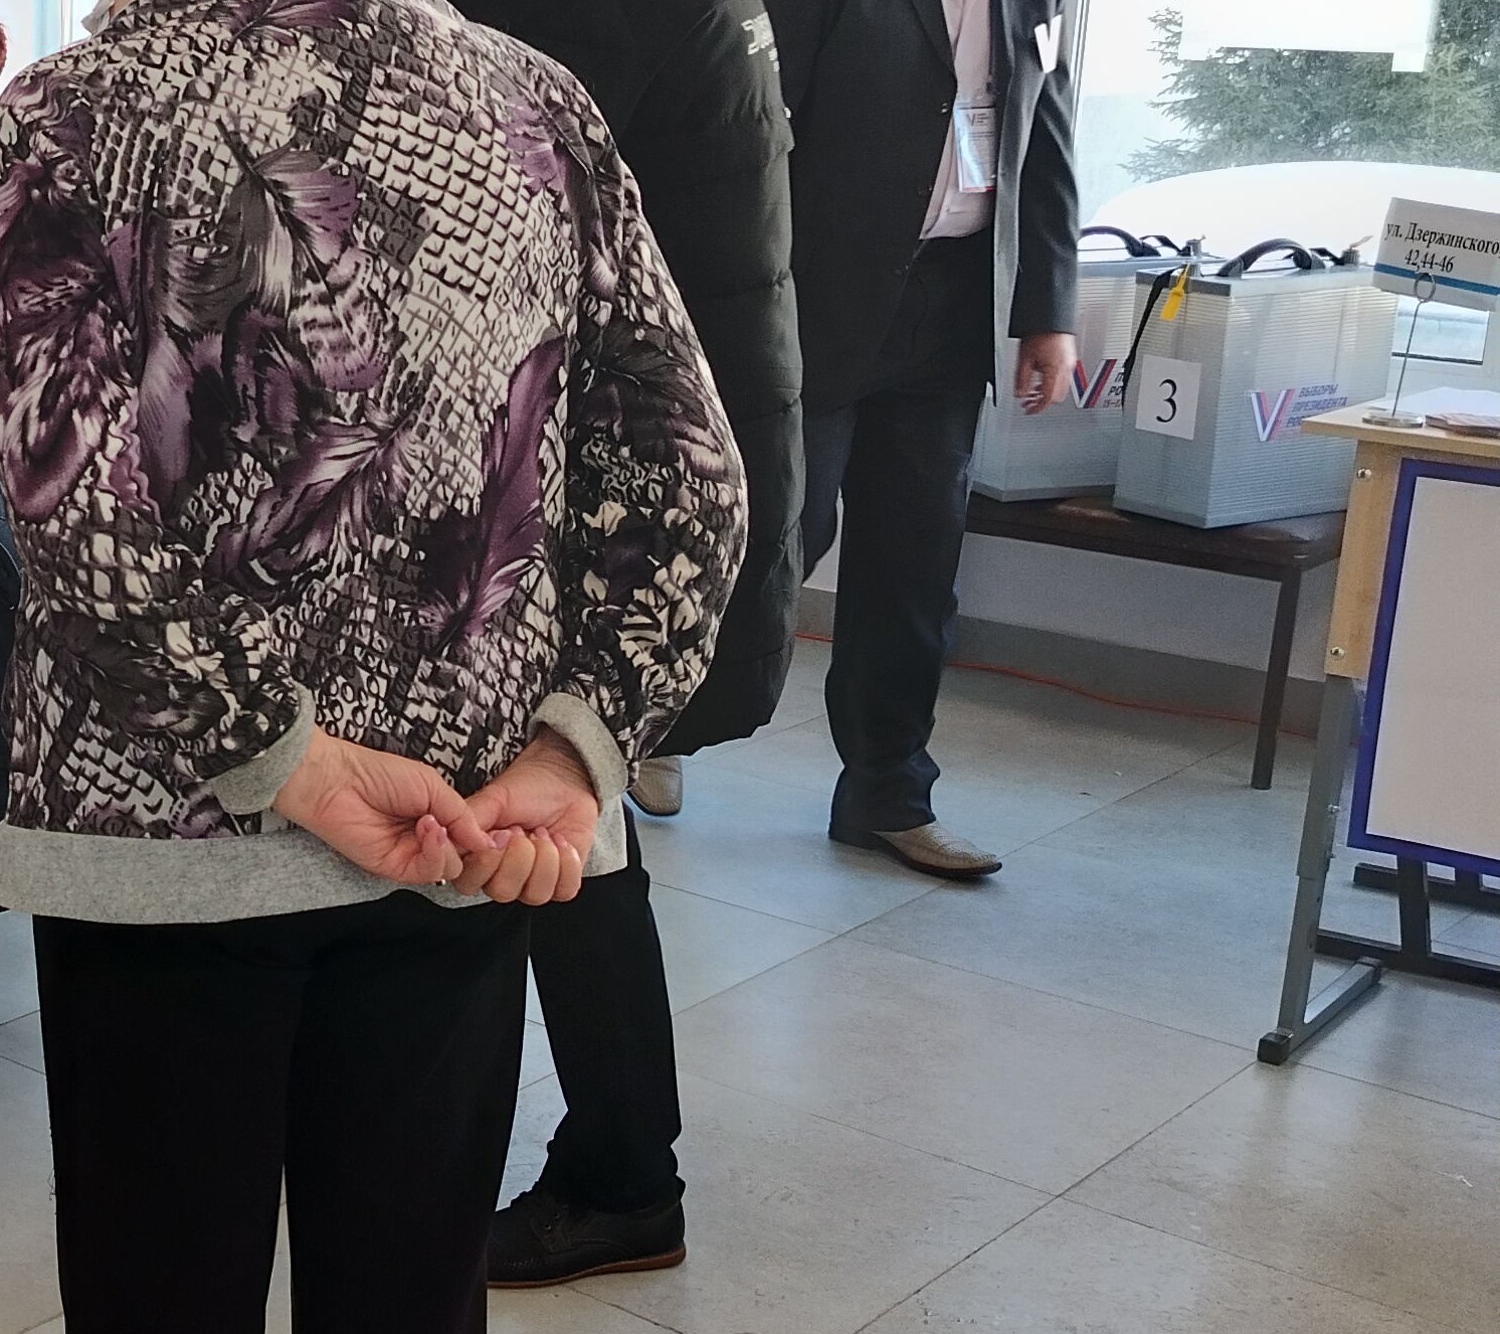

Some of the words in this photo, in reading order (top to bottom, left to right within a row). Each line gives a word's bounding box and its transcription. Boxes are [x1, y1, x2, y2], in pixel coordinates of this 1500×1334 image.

[1384, 223, 1403, 241] ул.
[1405, 248, 1456, 273] 42,44-46
[1299, 384, 1338, 398] ВЫБОРЫ
[1156, 378, 1177, 423] 3
[1292, 397, 1348, 412] ПРЕЗИДЕНТА
